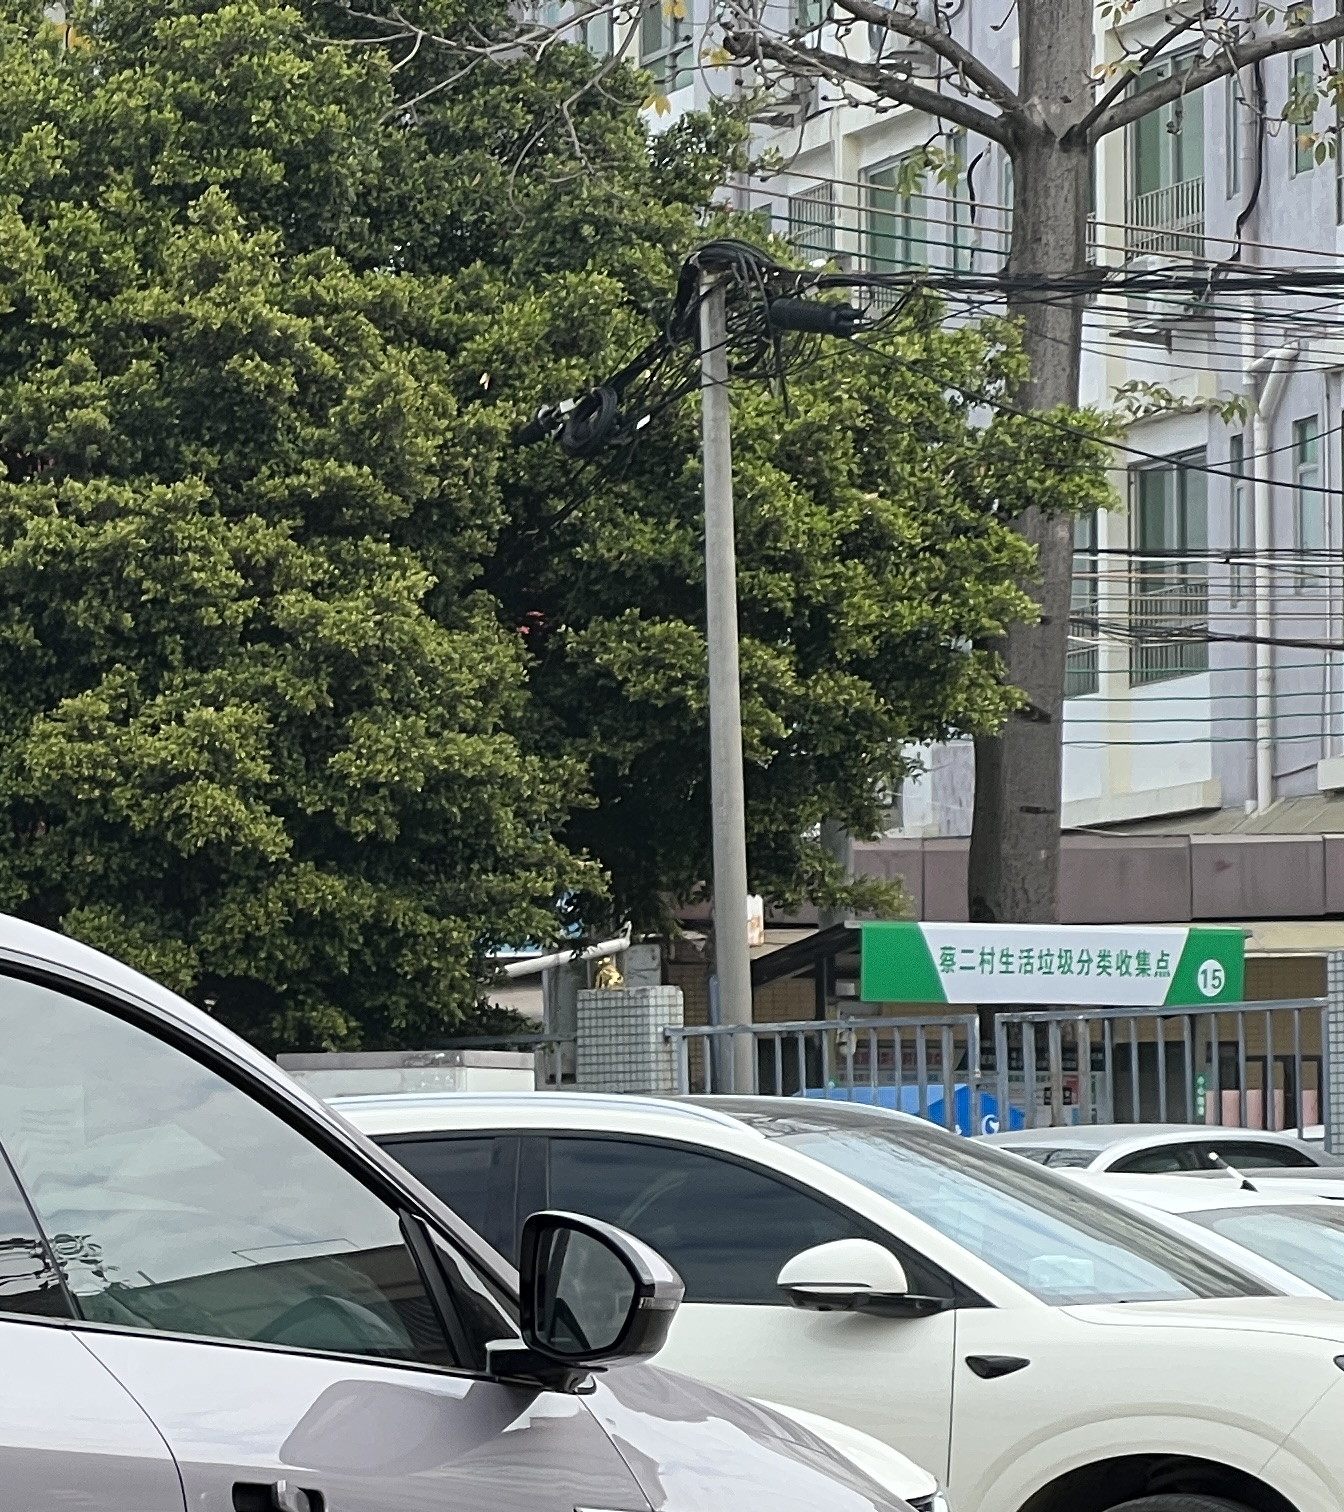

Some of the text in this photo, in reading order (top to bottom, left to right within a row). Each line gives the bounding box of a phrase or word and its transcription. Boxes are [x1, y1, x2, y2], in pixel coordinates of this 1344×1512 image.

[938, 945, 1172, 979] 蔡二村生活垃圾分类收集点
[1199, 967, 1223, 990] 15
